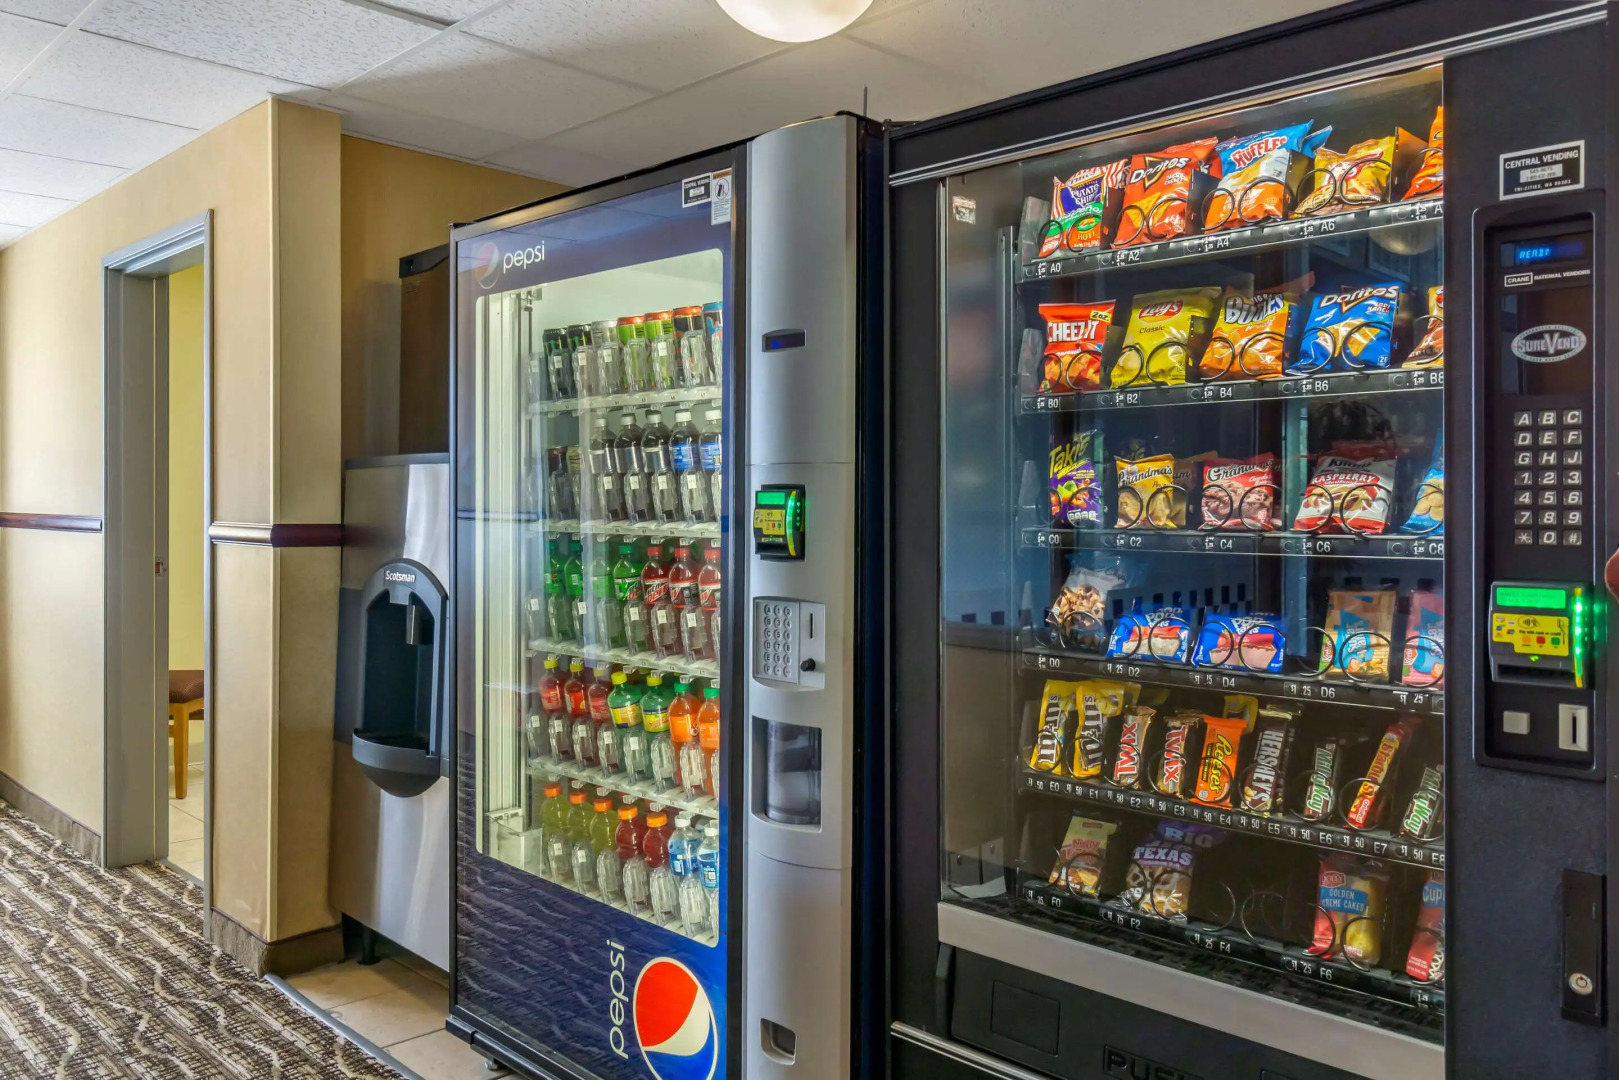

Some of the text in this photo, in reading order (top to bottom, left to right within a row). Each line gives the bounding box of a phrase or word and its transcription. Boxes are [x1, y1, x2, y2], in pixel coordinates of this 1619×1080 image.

[1231, 136, 1287, 169] RUFFLES
[1505, 150, 1578, 169] CENTRAL VENDING
[1130, 157, 1190, 184] Doritos
[1320, 220, 1335, 231] A6
[1217, 237, 1229, 248] A4
[503, 240, 545, 273] pepsi
[1128, 251, 1140, 261] A2
[1520, 248, 1550, 258] READY
[1050, 263, 1061, 273] A0
[1320, 285, 1399, 308] Doritos
[1139, 325, 1165, 334] Classic
[1315, 380, 1329, 391] B6
[1220, 387, 1232, 397] B4
[1126, 393, 1138, 403] B2
[1518, 411, 1579, 425] A B C
[1518, 431, 1578, 445] D E F
[1518, 452, 1578, 464] G H J
[1118, 465, 1173, 486] Grandma's
[1521, 472, 1579, 484] 1 2 3
[1519, 492, 1579, 503] 4 5 6
[1520, 512, 1579, 523] 7 8 9
[1130, 537, 1142, 546] C2
[1220, 539, 1233, 550] C4
[1316, 541, 1331, 552] C6
[385, 570, 415, 582] Scotsman
[1128, 667, 1140, 678] D2
[1223, 677, 1235, 688] D4
[1321, 687, 1335, 699] D6
[1210, 734, 1233, 794] Reese's
[1252, 729, 1284, 808] HERSHEY'S
[1050, 781, 1060, 791] E0
[1089, 789, 1099, 798] E1
[1130, 797, 1141, 807] E2
[1174, 805, 1185, 816] E3
[1220, 815, 1231, 826] E4
[1268, 823, 1280, 834] E5
[1319, 832, 1332, 844] E6
[1374, 842, 1388, 854] E7
[1134, 847, 1193, 867] TEXAS
[1329, 888, 1355, 900] GOLDEN
[1052, 897, 1061, 908] F0
[1344, 902, 1365, 911] CAKES
[1131, 919, 1141, 929] F2
[1220, 941, 1231, 953] F4
[1320, 969, 1332, 980] F6
[607, 939, 629, 1059] pepsi
[1107, 1050, 1184, 1080] PU
